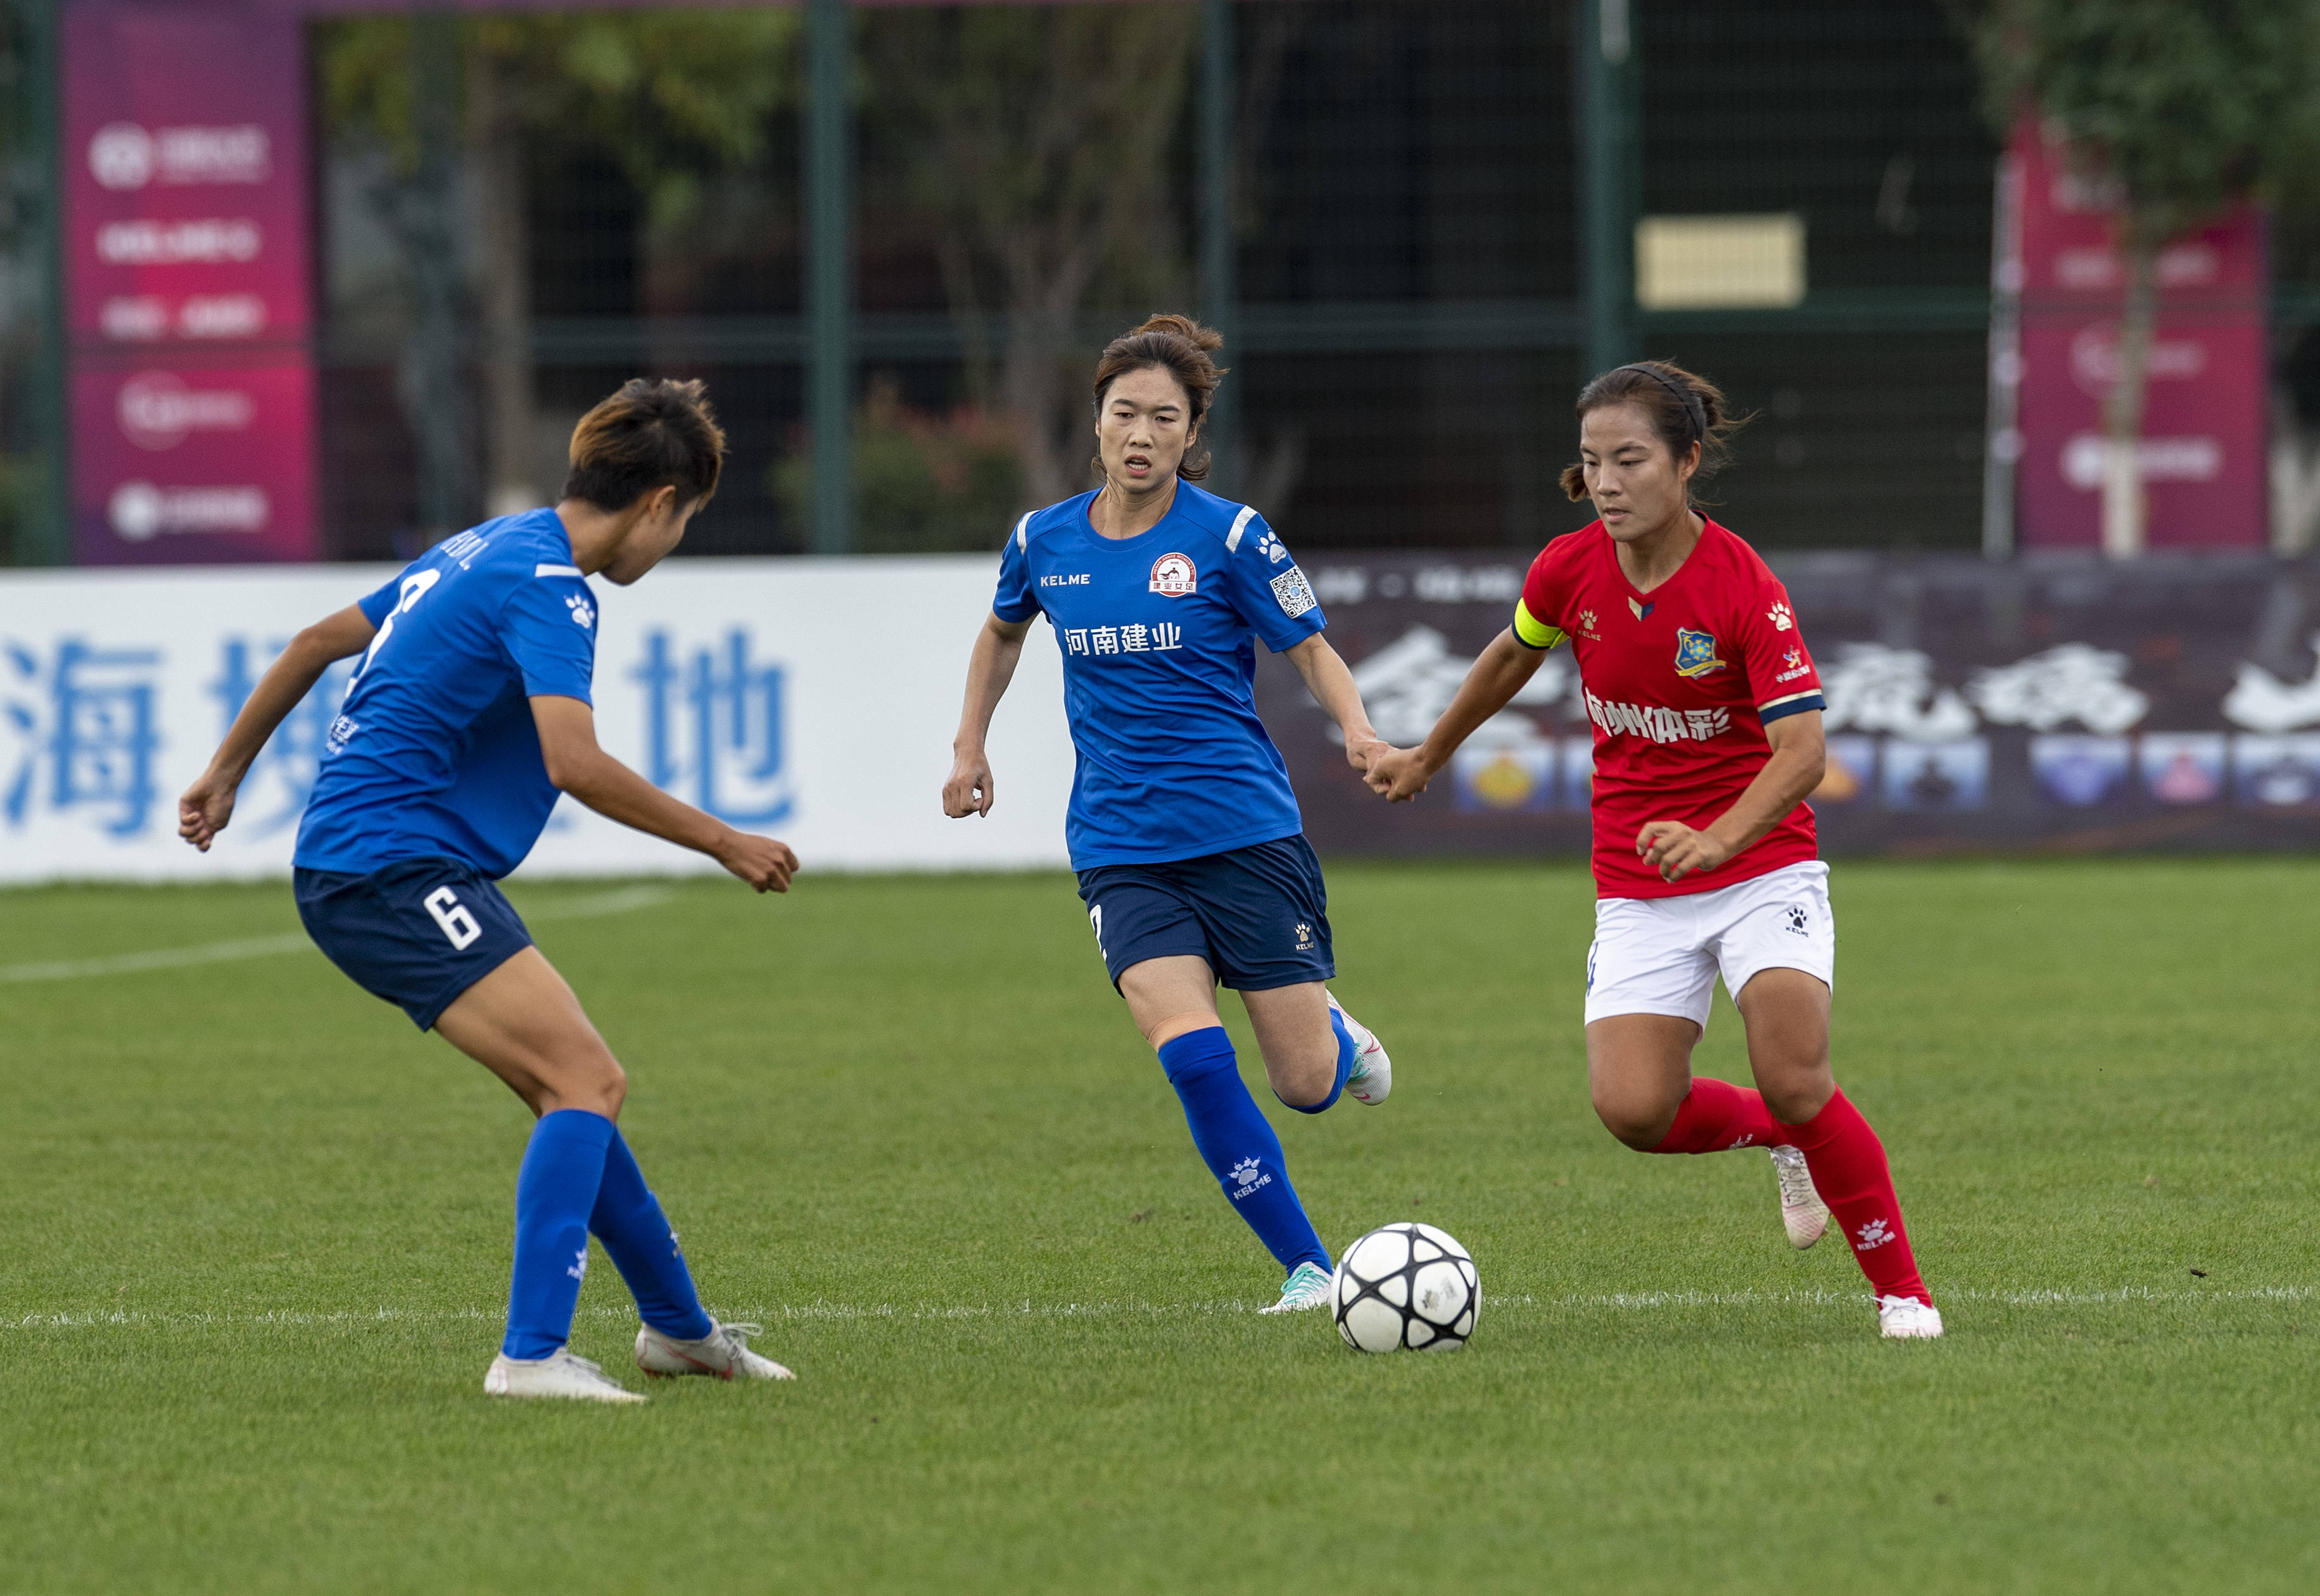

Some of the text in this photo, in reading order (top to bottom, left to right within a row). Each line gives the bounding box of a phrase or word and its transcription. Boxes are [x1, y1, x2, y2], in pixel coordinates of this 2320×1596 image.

[1040, 574, 1091, 588] KELME
[1064, 621, 1183, 656] 河南建业
[423, 885, 483, 951] 6
[1785, 926, 1810, 939] KELME
[1295, 942, 1314, 951] KELME
[1233, 1173, 1272, 1200] KELME
